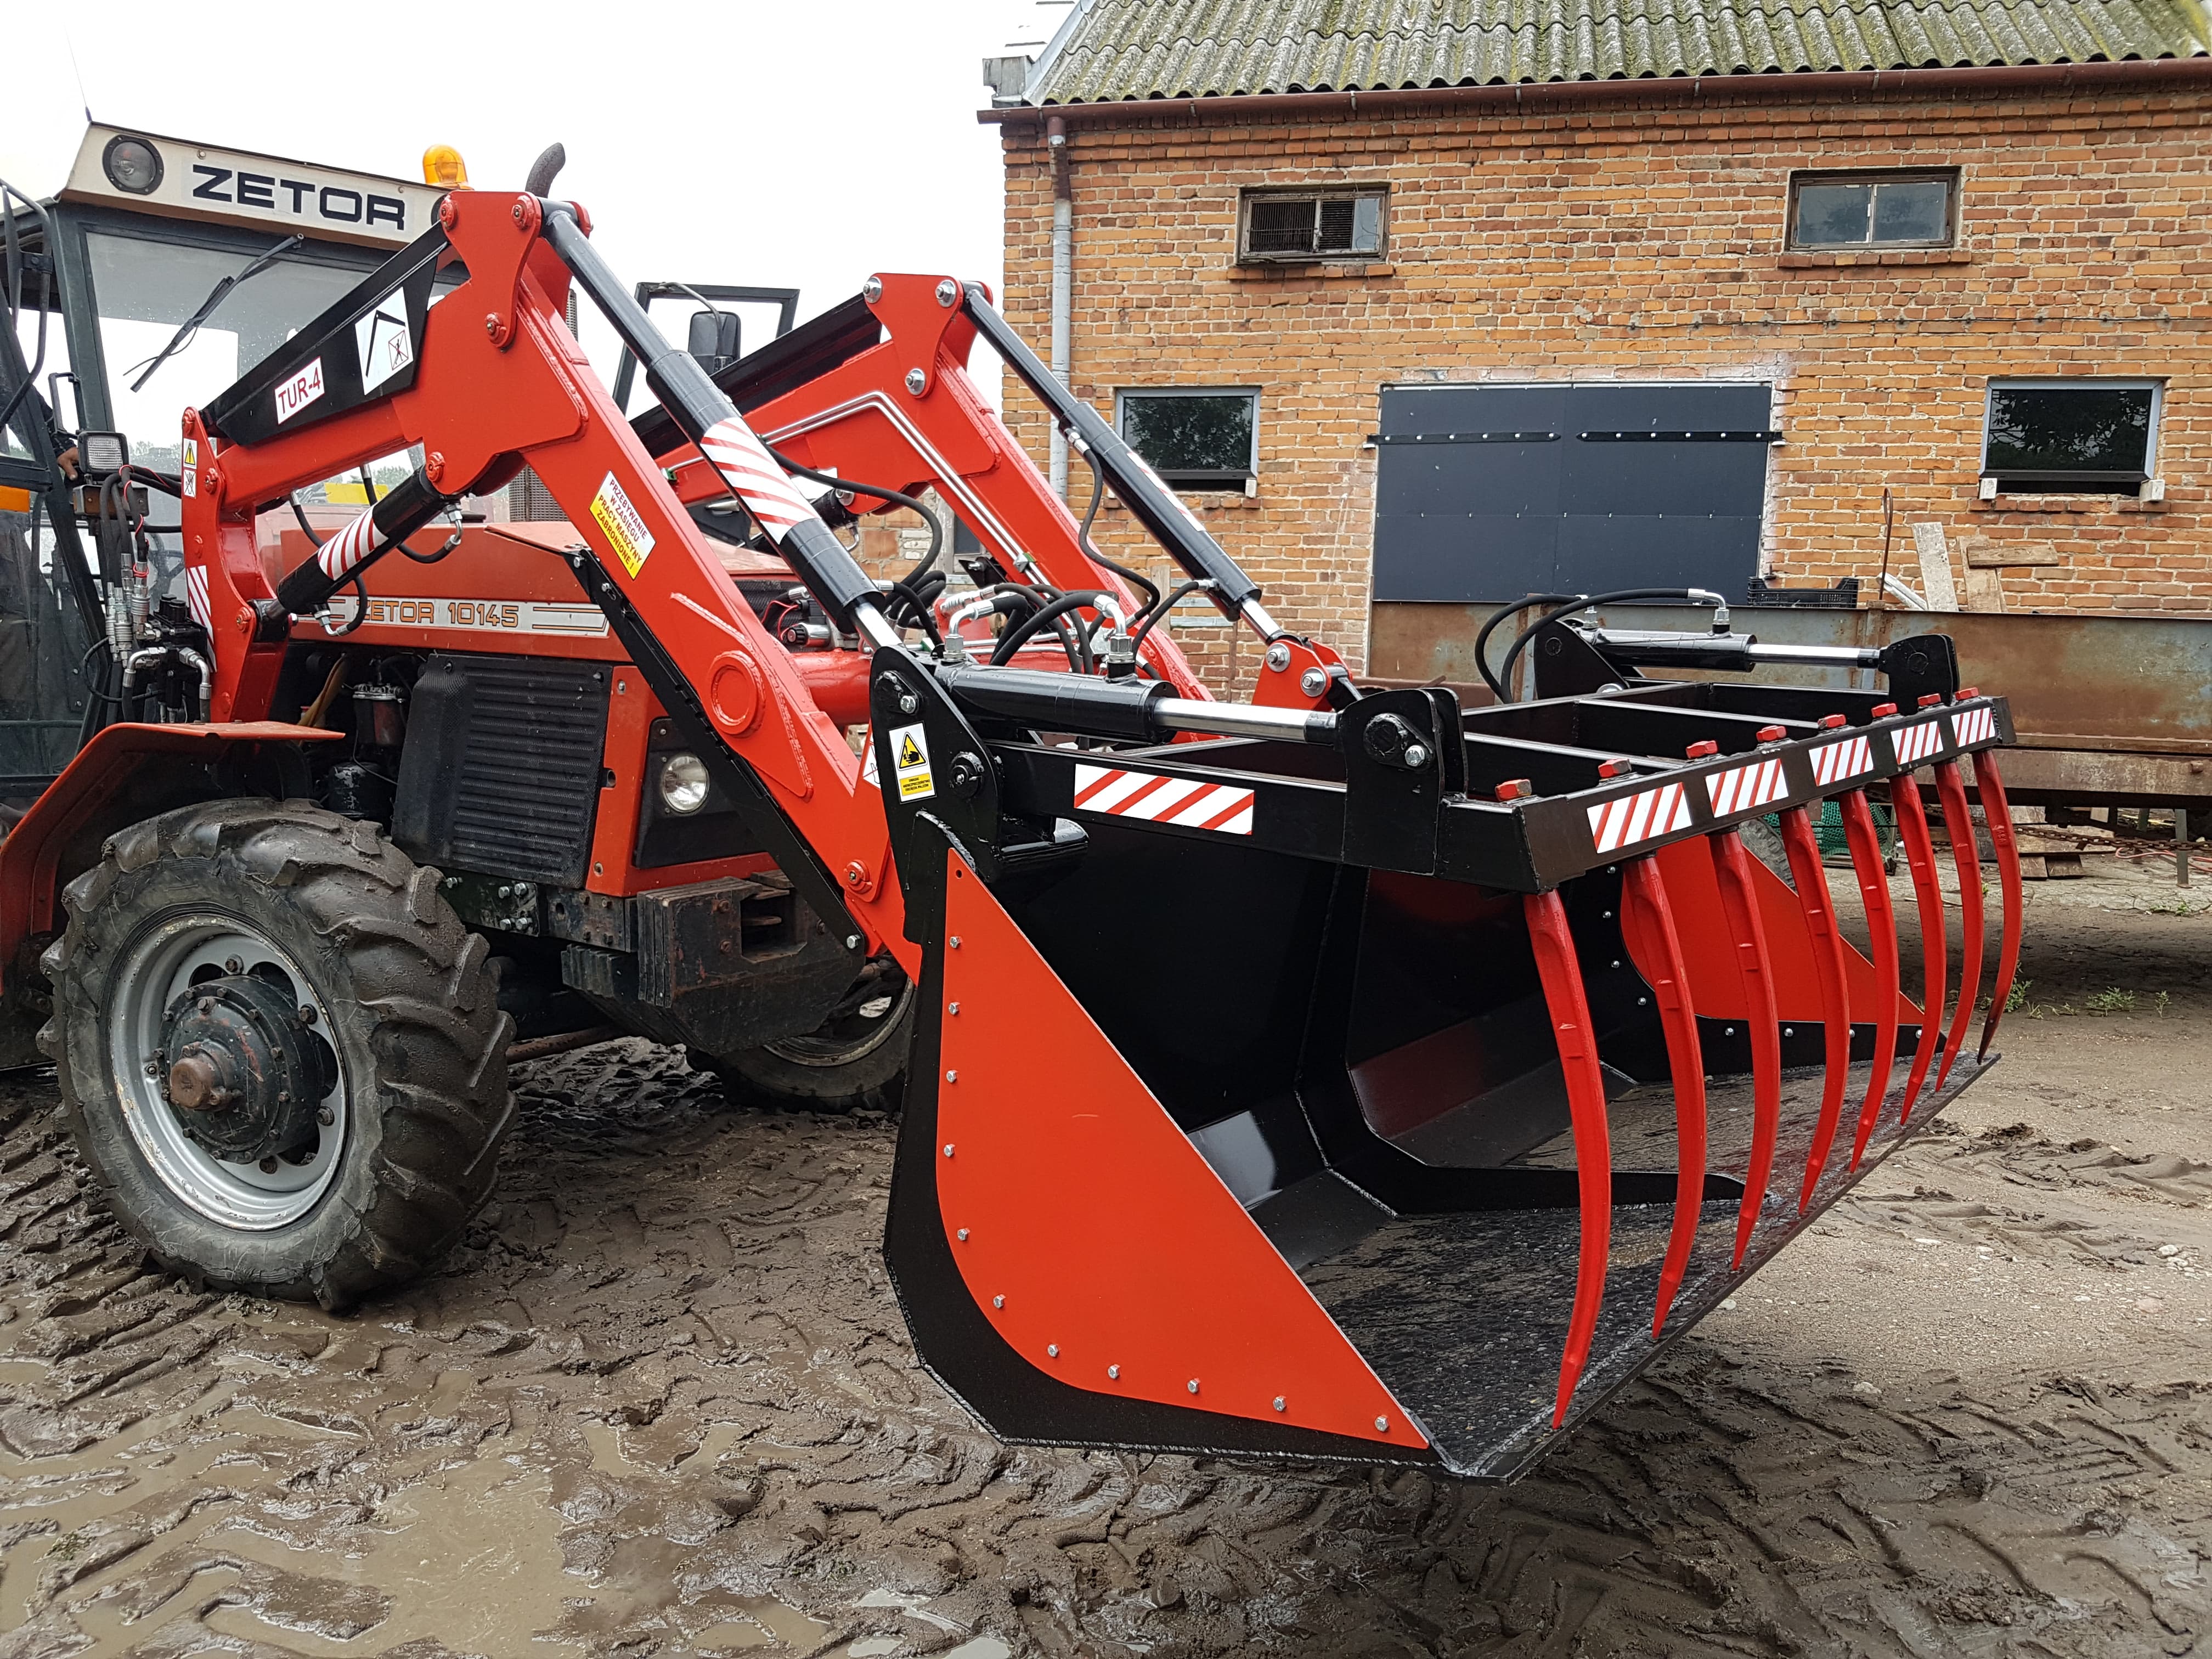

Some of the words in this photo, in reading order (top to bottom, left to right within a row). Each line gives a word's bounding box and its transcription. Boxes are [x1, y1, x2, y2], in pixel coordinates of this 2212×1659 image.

[193, 165, 405, 230] ZETOR
[278, 366, 321, 414] TUR-4
[596, 509, 631, 565] ZABRONIONE
[598, 494, 617, 523] PRACY
[615, 523, 642, 563] MASZYNY
[610, 479, 647, 539] PRZEBYWANIE
[610, 495, 617, 506] W
[615, 504, 640, 542] ZASIĘGU
[448, 602, 519, 628] 10145
